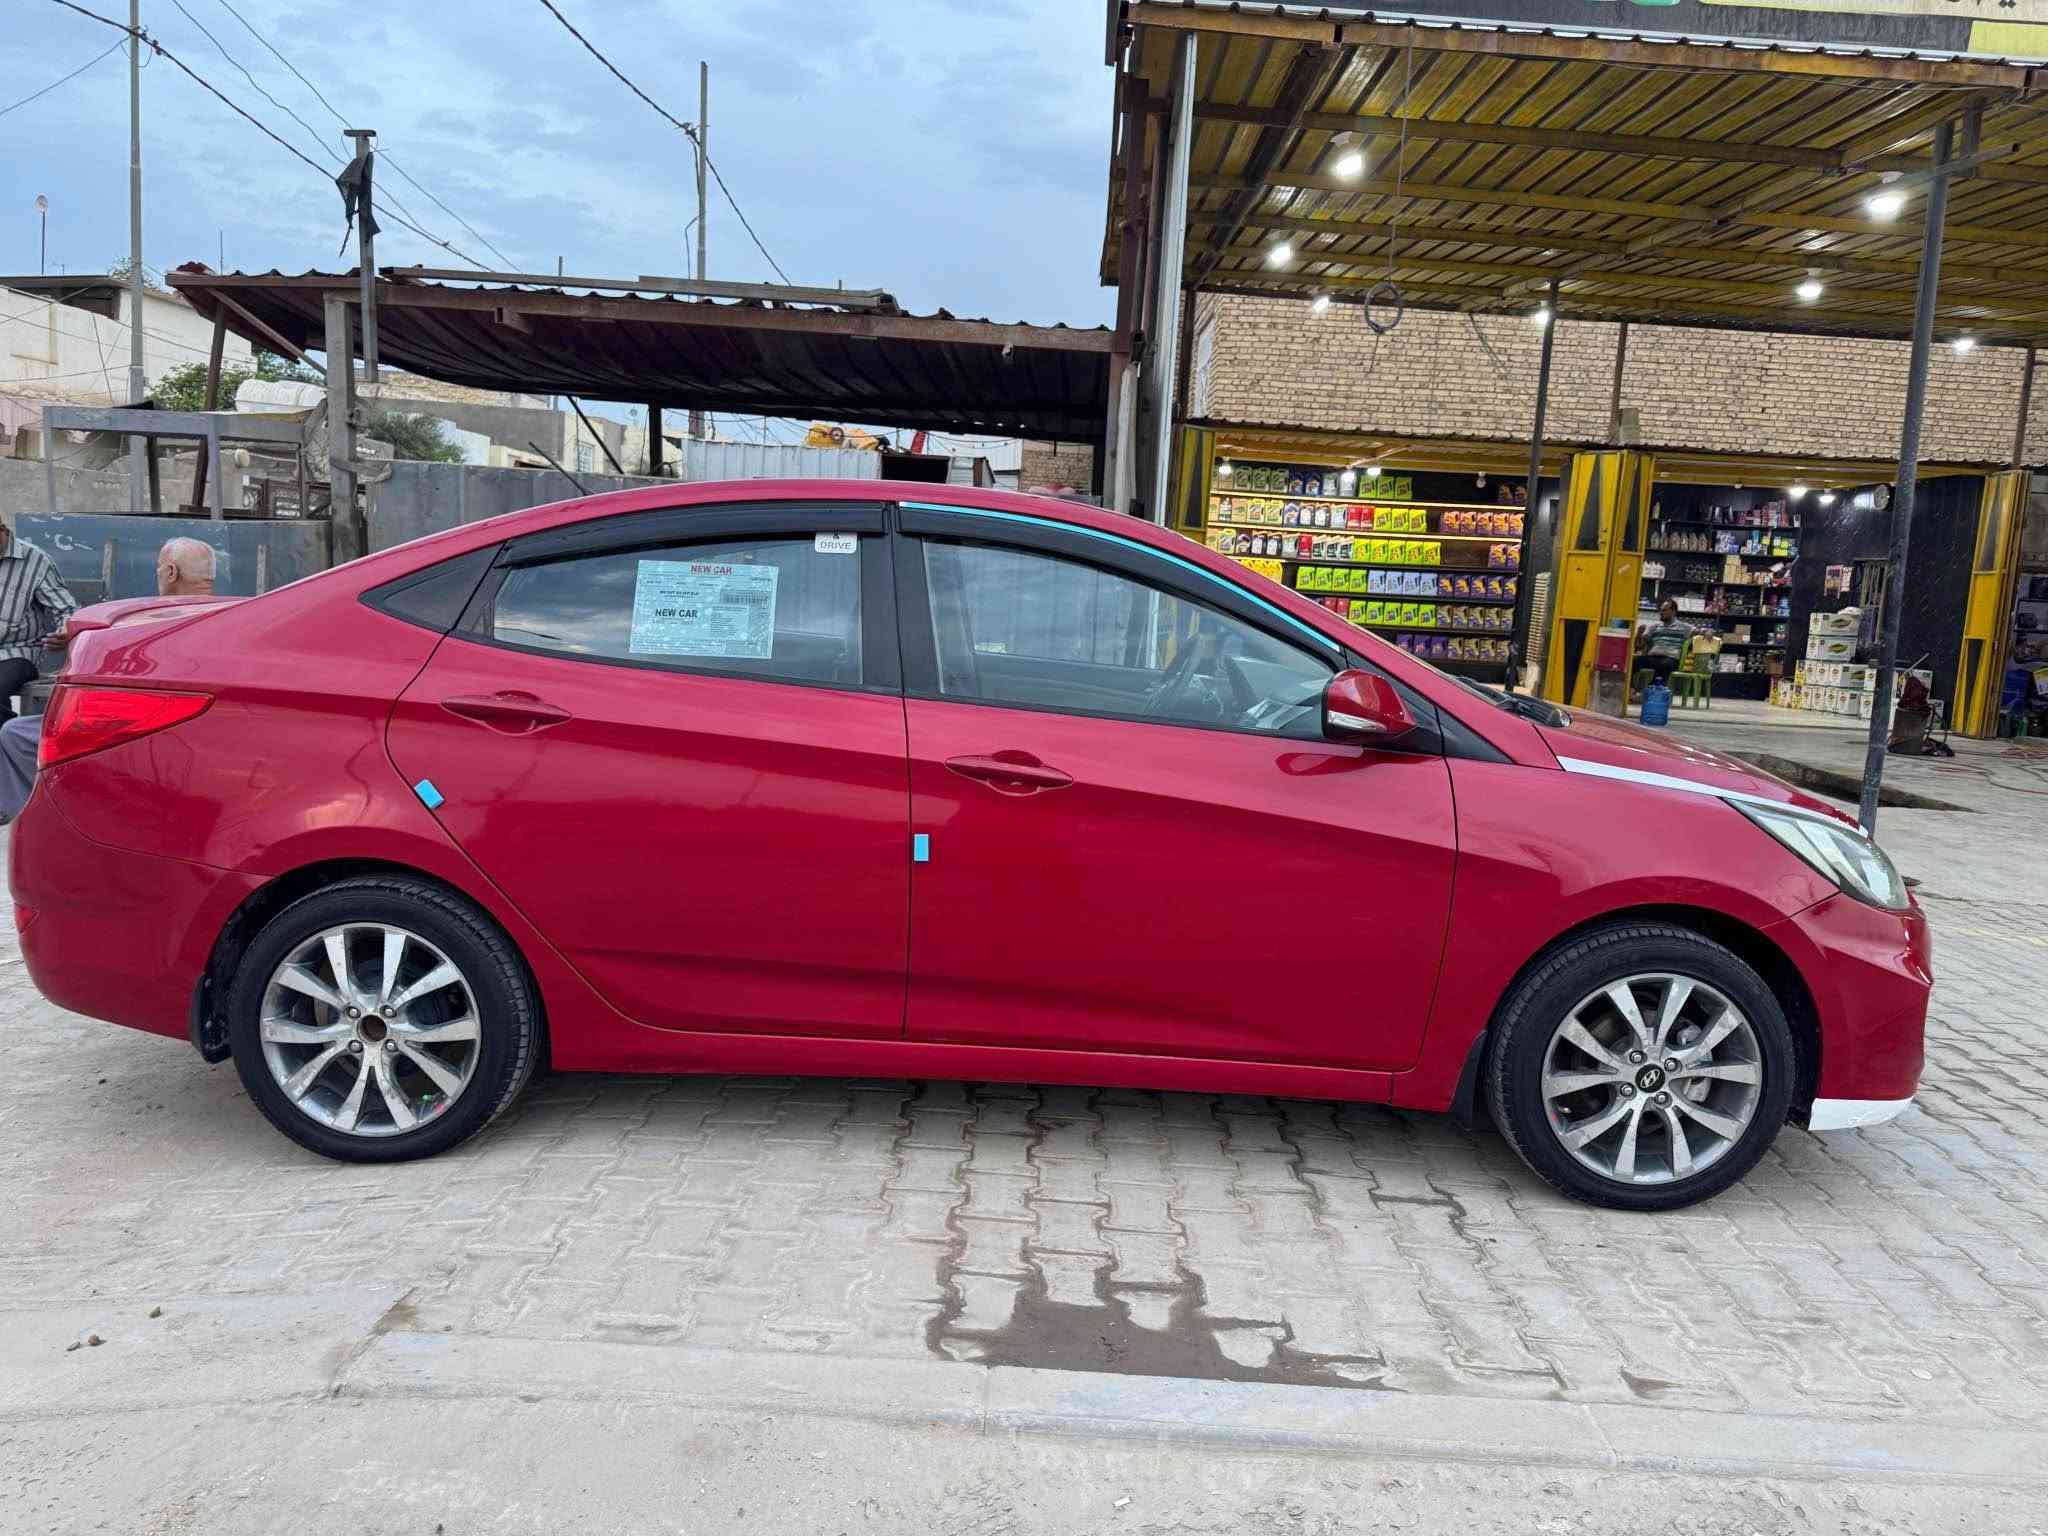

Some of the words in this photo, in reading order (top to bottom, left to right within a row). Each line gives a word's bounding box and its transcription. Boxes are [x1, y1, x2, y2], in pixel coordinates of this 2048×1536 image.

[820, 541, 851, 550] DRIVE
[690, 564, 712, 574] NEW
[713, 566, 732, 576] CAR
[655, 608, 677, 617] NEW
[678, 609, 698, 618] CAR
